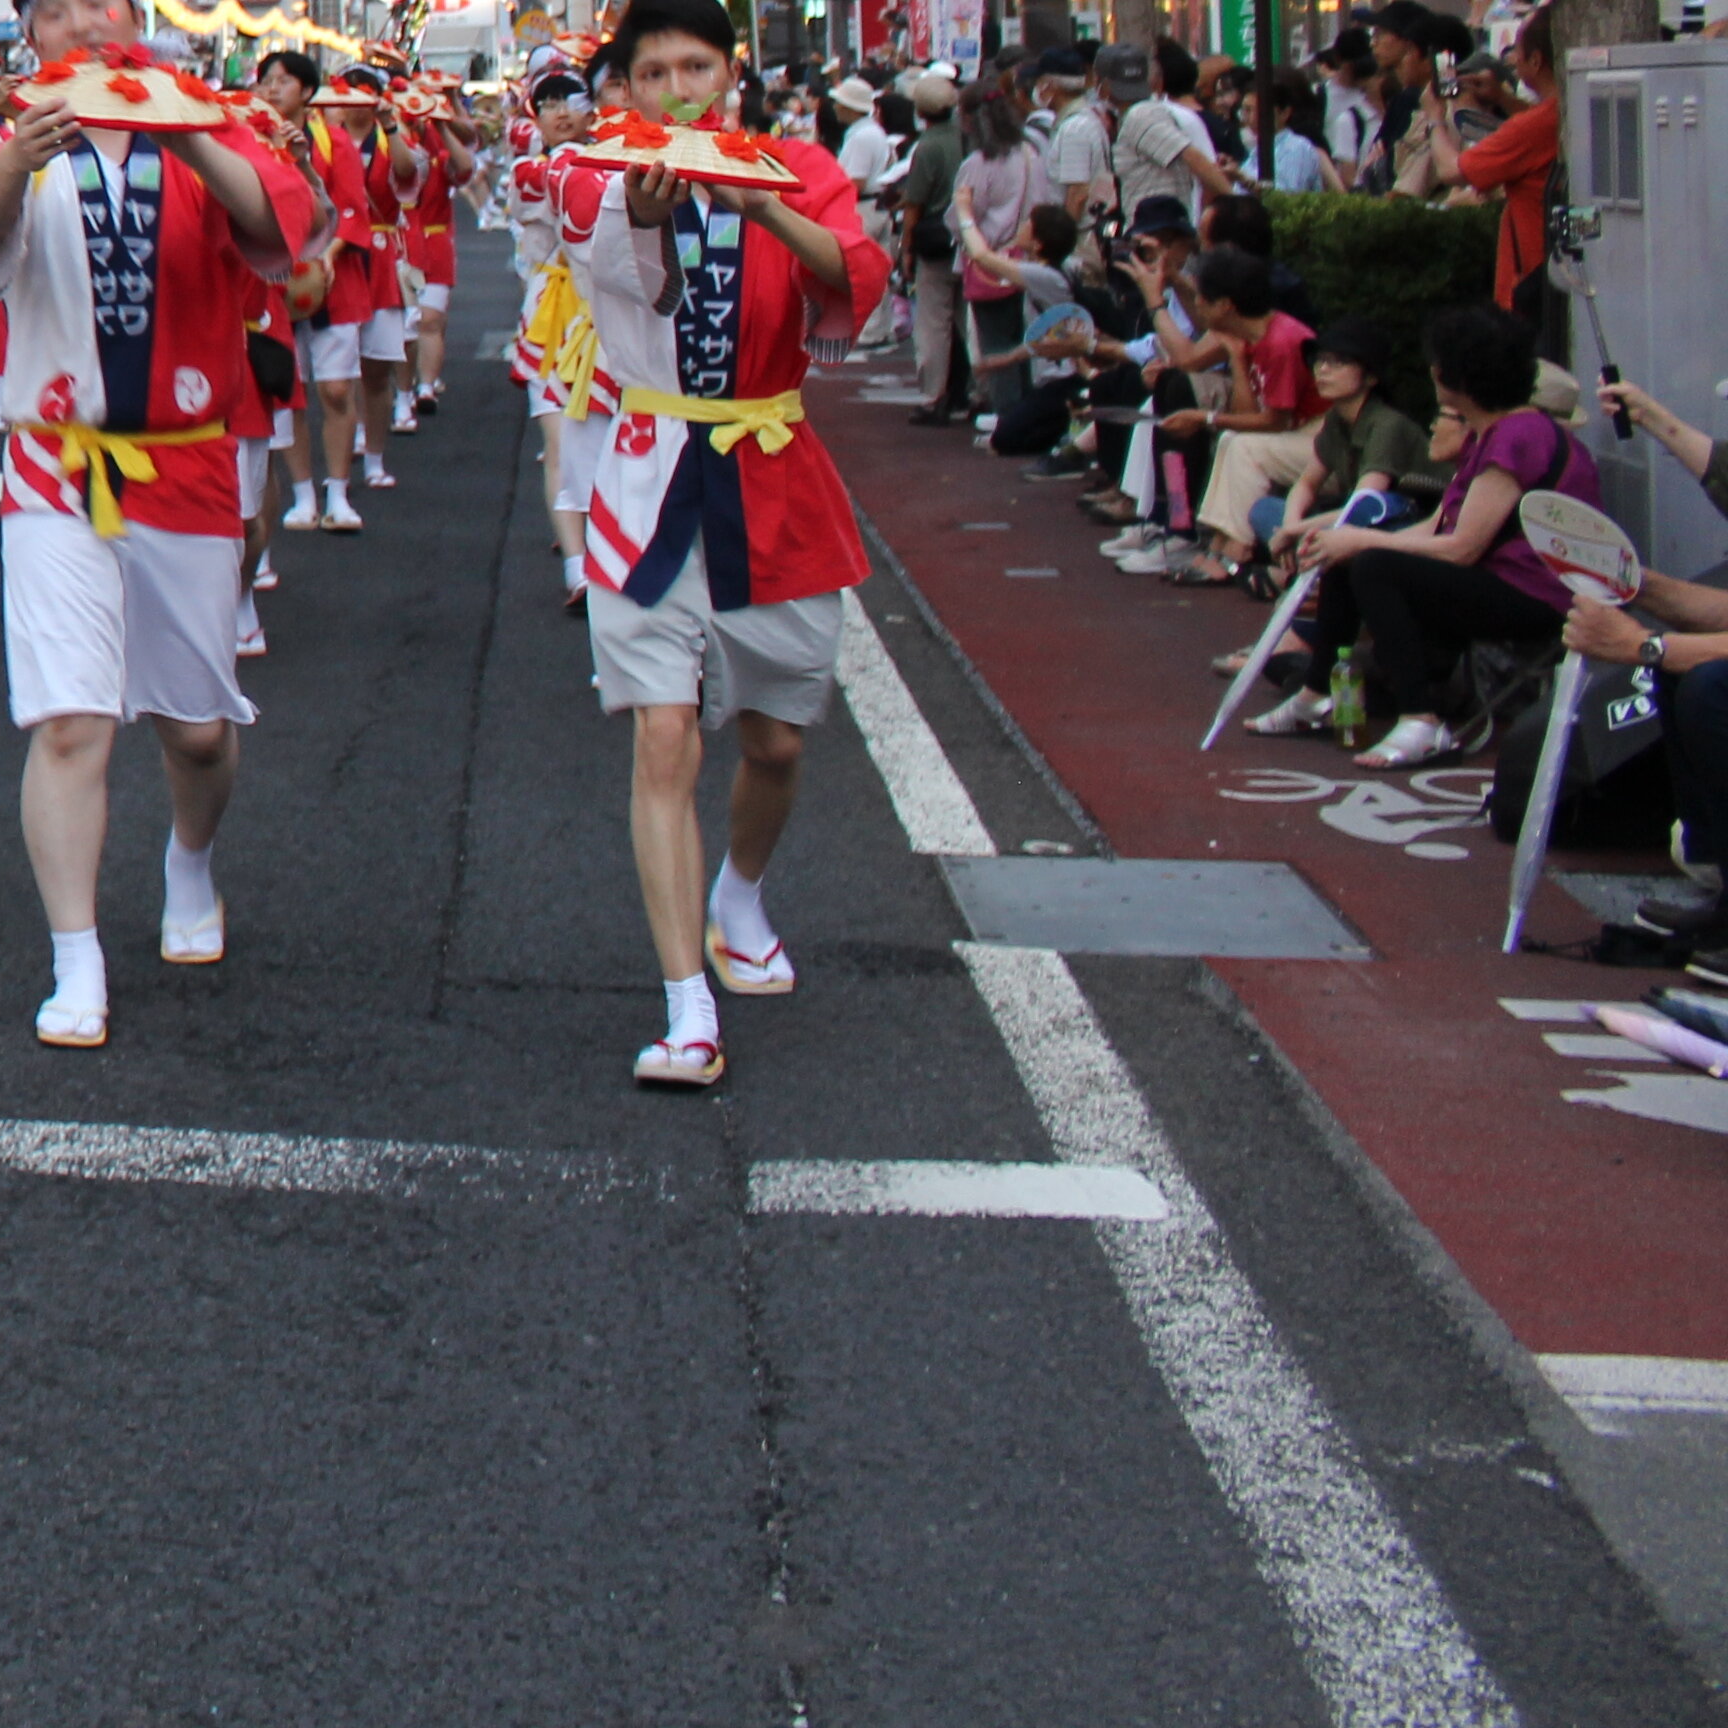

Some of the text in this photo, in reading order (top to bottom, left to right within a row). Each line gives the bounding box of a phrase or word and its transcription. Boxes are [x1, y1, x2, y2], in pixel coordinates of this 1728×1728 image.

[117, 198, 156, 336] ヤマサワ
[699, 262, 736, 398] ヤマサワ
